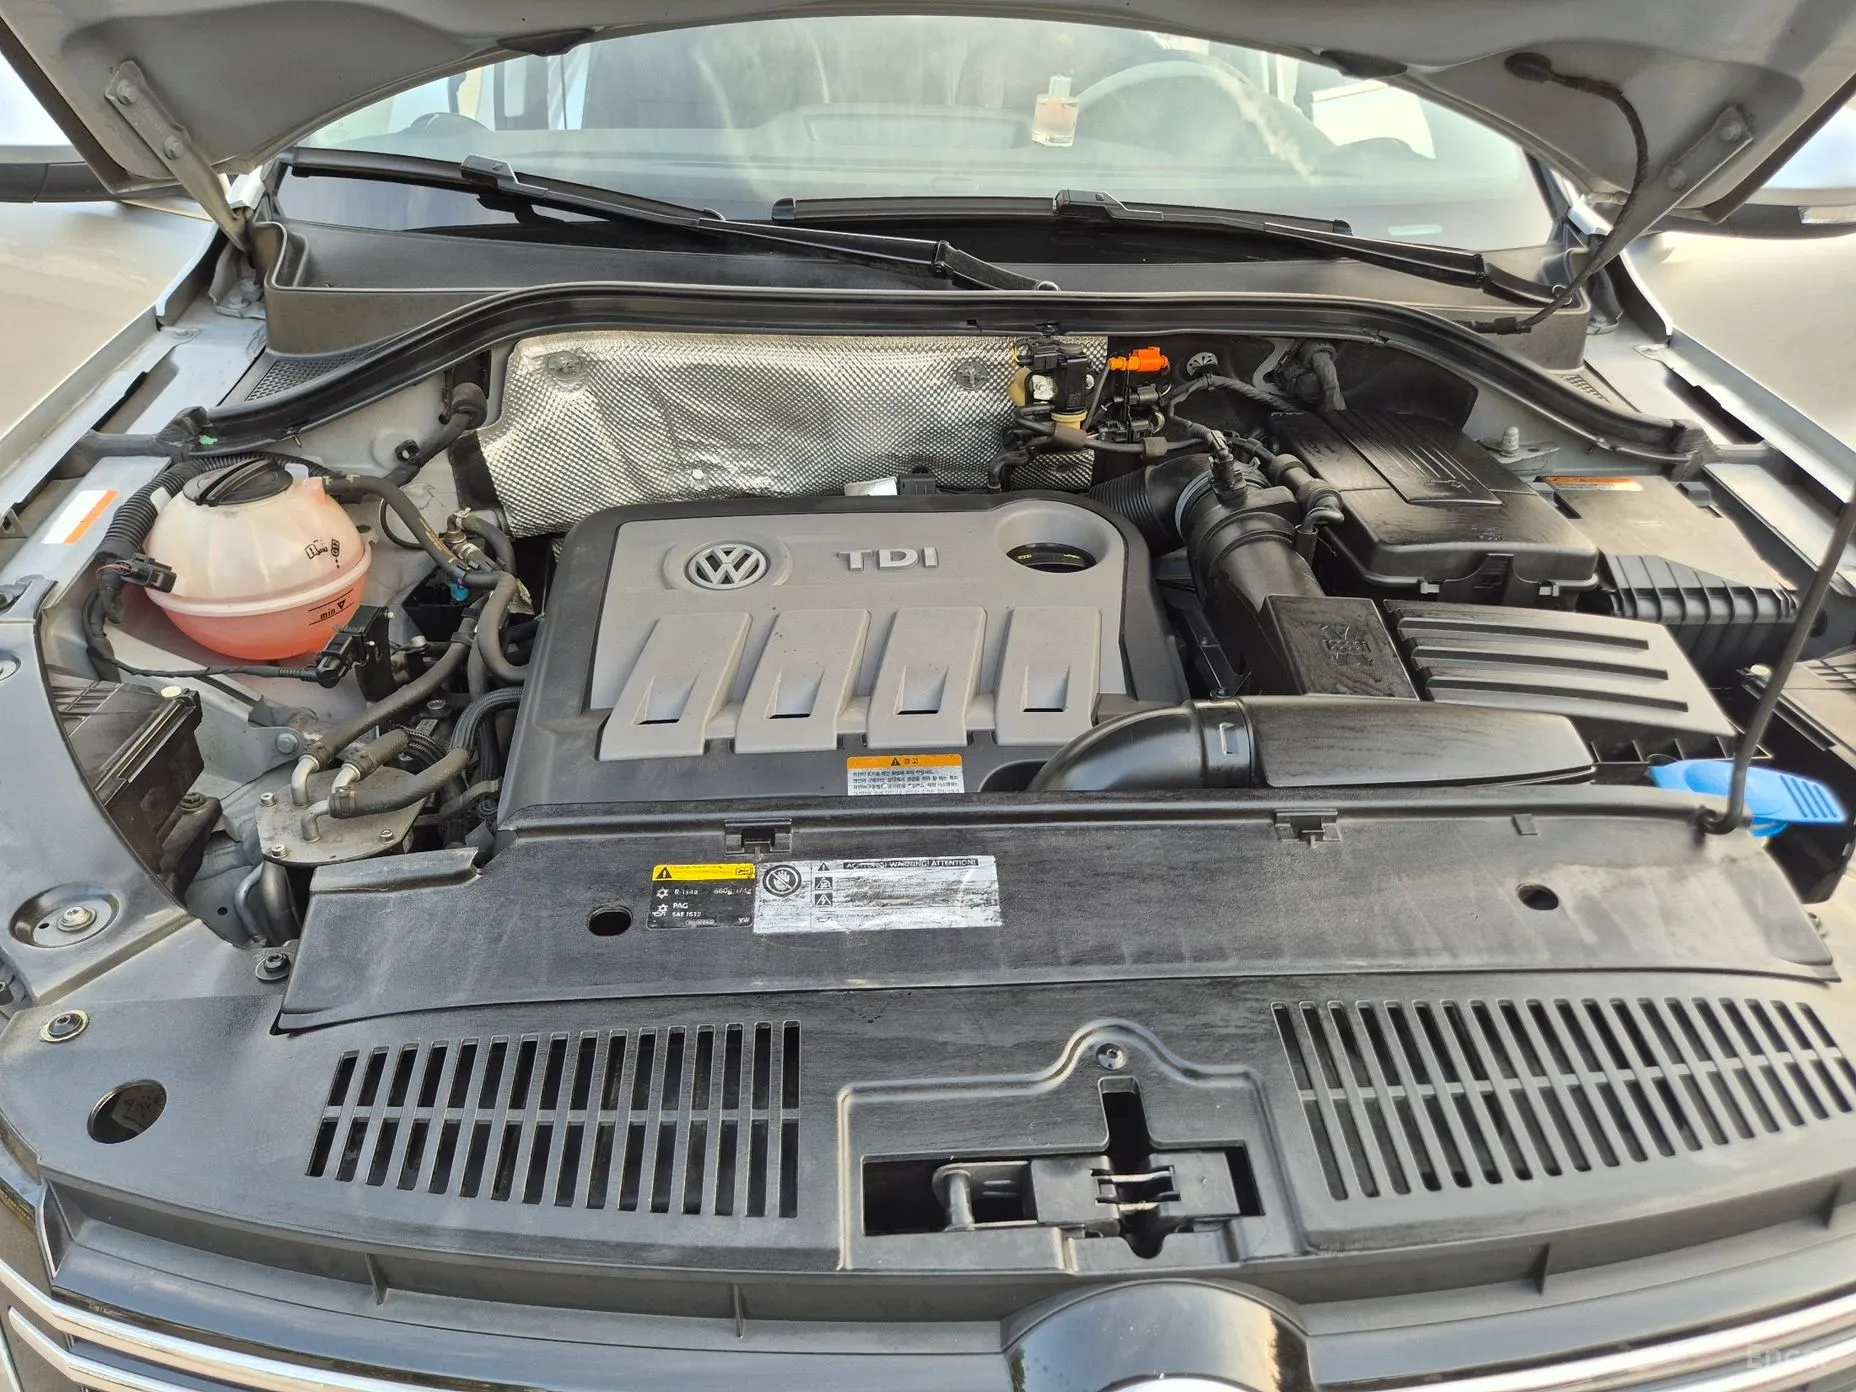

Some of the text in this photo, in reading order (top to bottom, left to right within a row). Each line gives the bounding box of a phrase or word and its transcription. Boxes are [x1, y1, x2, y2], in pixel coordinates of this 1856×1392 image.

[837, 546, 938, 571] TDI
[320, 608, 336, 619] min
[931, 859, 976, 867] ATTENTION!
